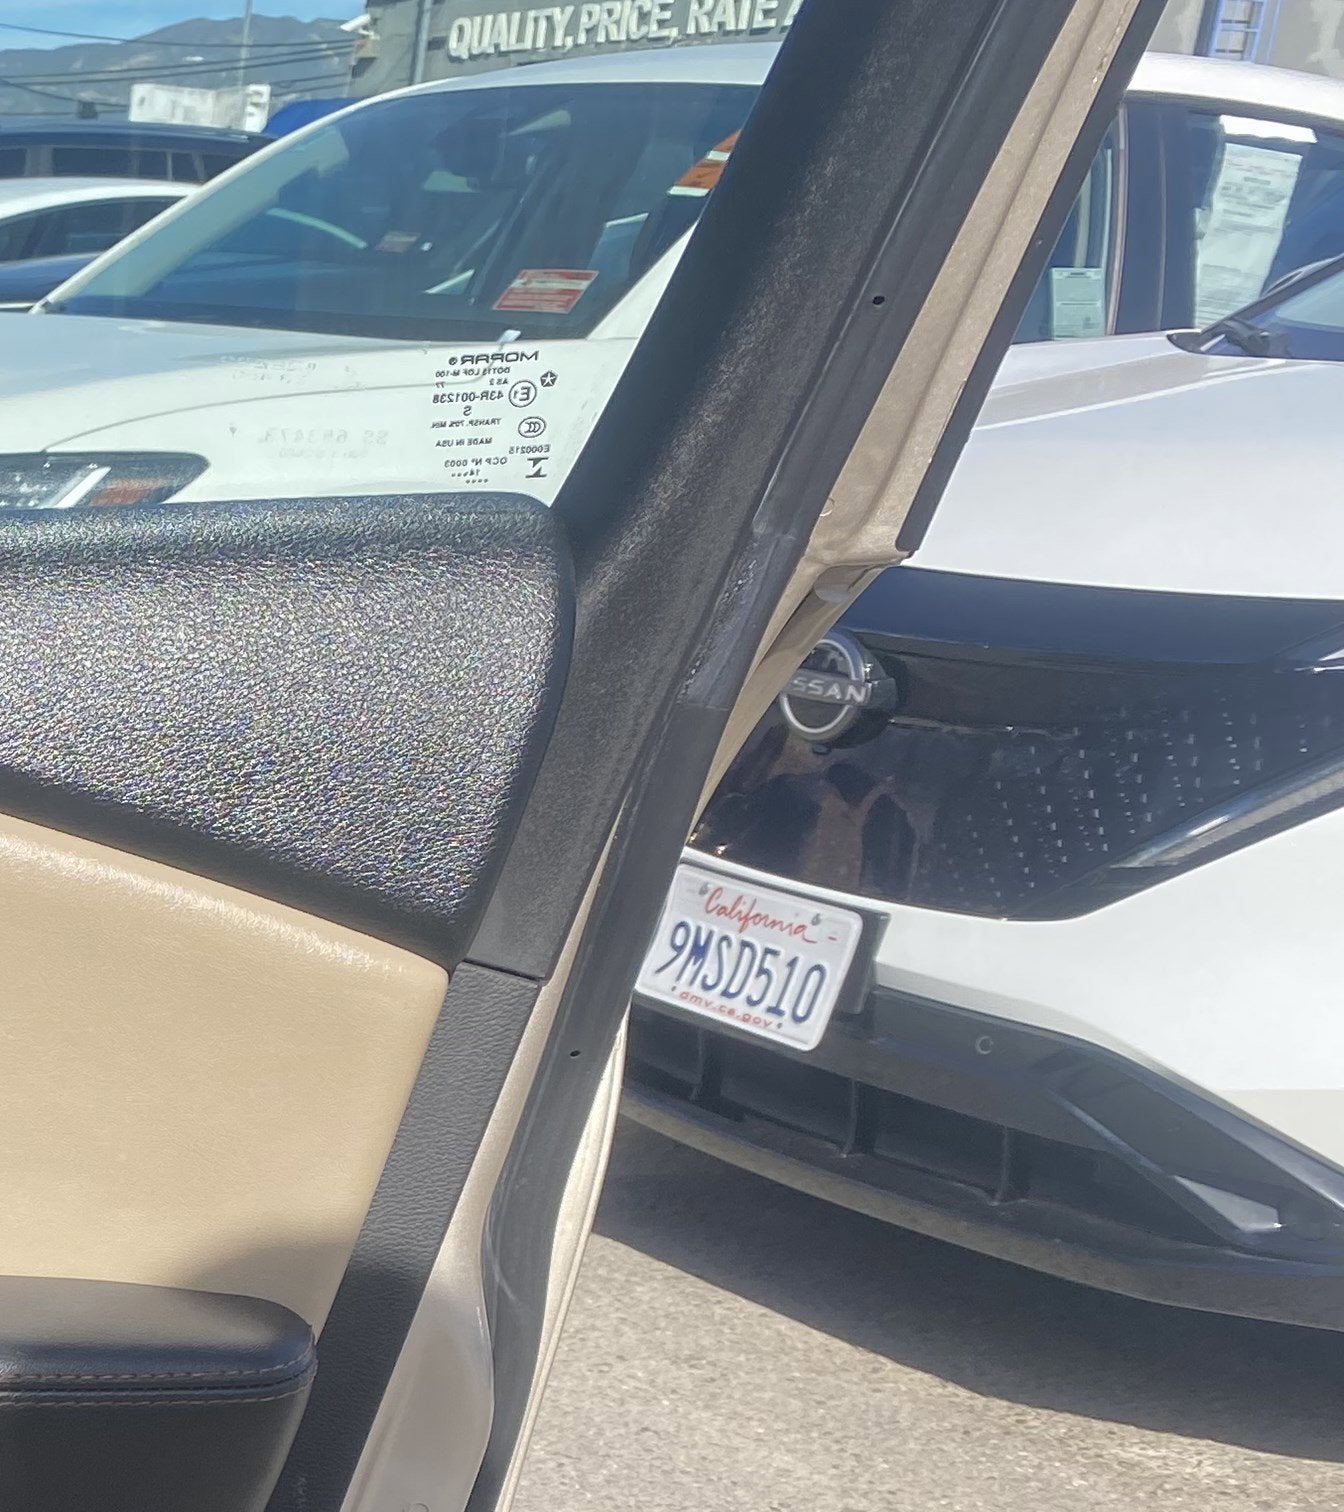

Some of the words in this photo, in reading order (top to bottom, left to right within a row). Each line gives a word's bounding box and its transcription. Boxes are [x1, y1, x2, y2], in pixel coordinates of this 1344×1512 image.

[790, 676, 867, 703] SSAN
[704, 886, 818, 944] California
[655, 920, 828, 1024] 9MSD510
